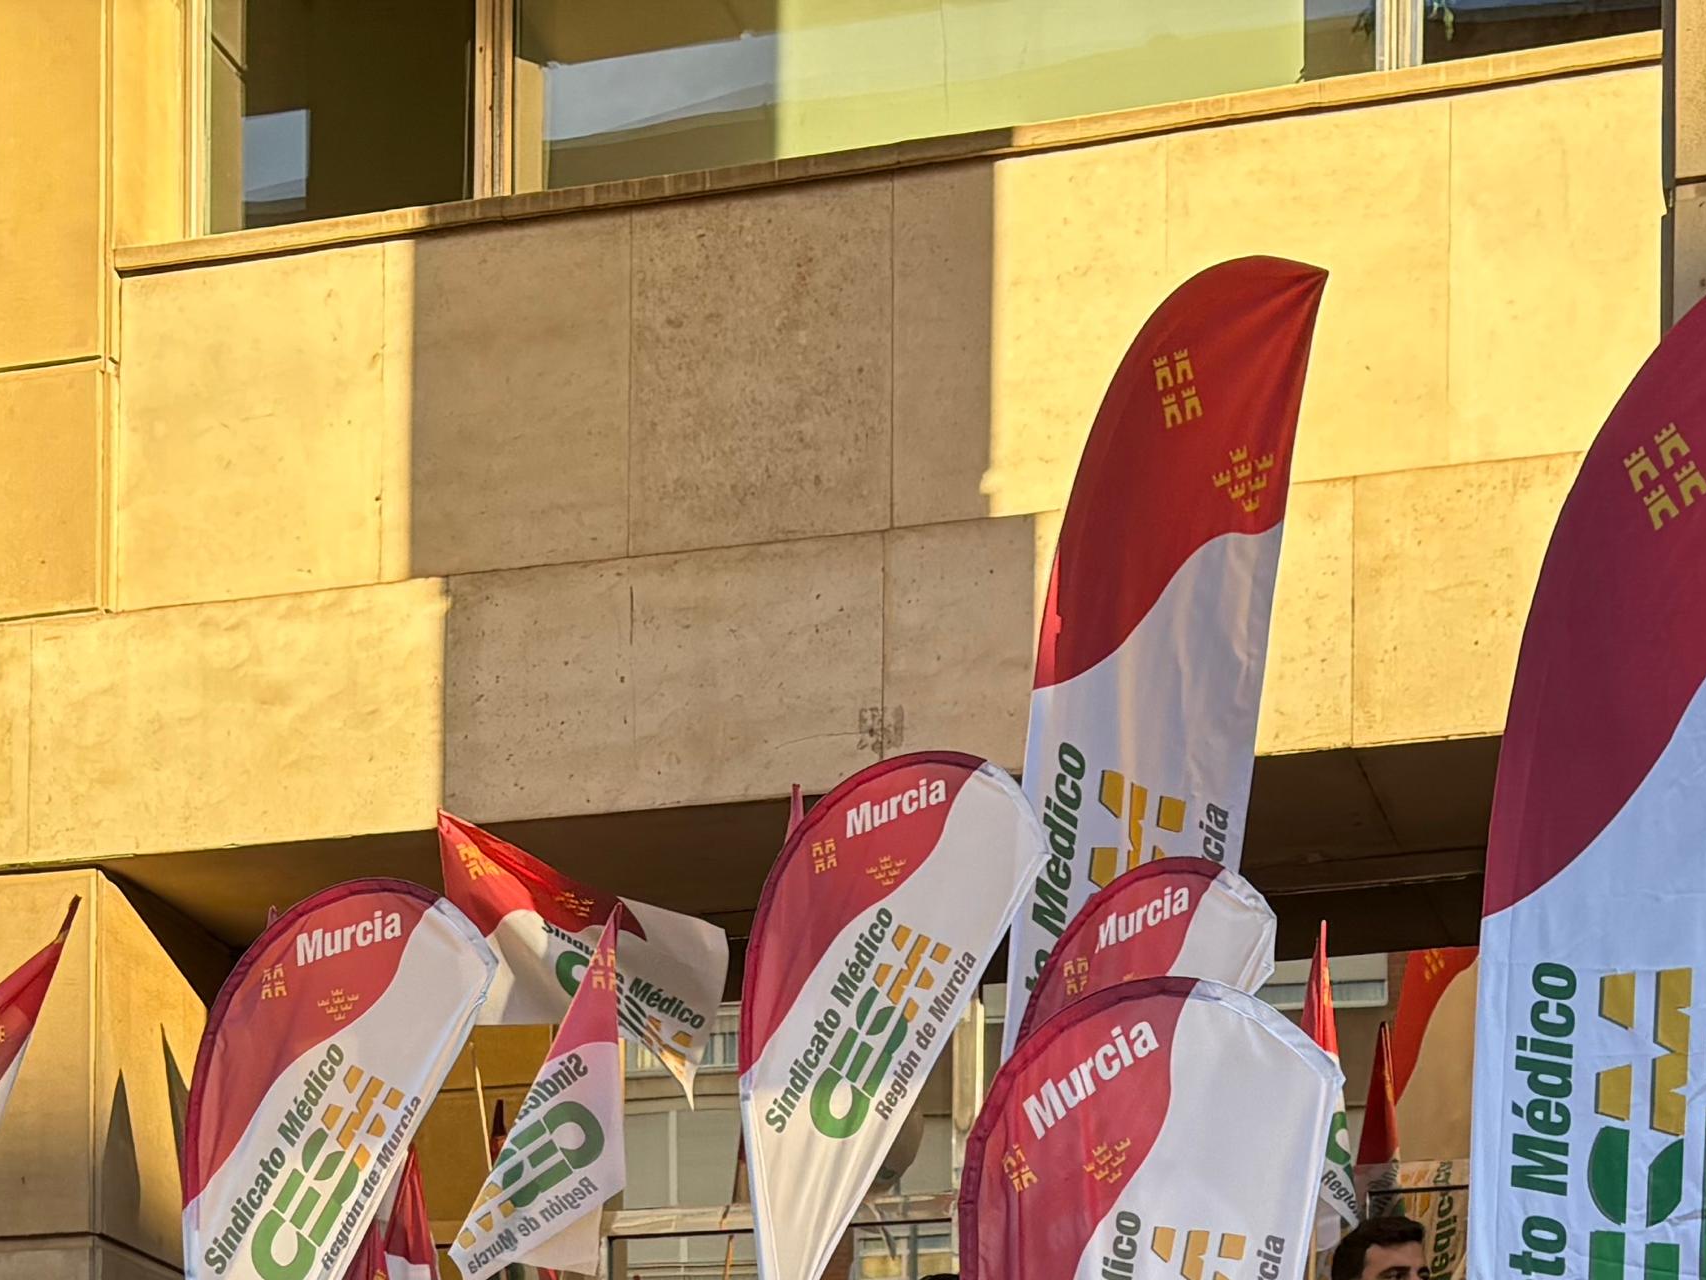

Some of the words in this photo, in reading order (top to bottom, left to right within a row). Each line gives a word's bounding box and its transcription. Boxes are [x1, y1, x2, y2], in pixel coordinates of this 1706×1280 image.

[844, 775, 948, 840] Murcia
[295, 910, 404, 968] Murcia
[1094, 881, 1191, 953] Murcia
[629, 976, 706, 1030] Médico
[764, 1007, 841, 1134] Sindicato
[830, 907, 893, 1008] Médico
[809, 924, 952, 1139] CESM
[875, 1051, 922, 1121] Región
[916, 1021, 937, 1051] de
[928, 950, 978, 1024] Murcia
[1023, 1012, 1161, 1141] Murcia
[1510, 960, 1579, 1194] Médico
[205, 1147, 286, 1275] Sindicato
[277, 1043, 344, 1148] Médico
[361, 1168, 381, 1200] de
[377, 1096, 421, 1170] Murcia
